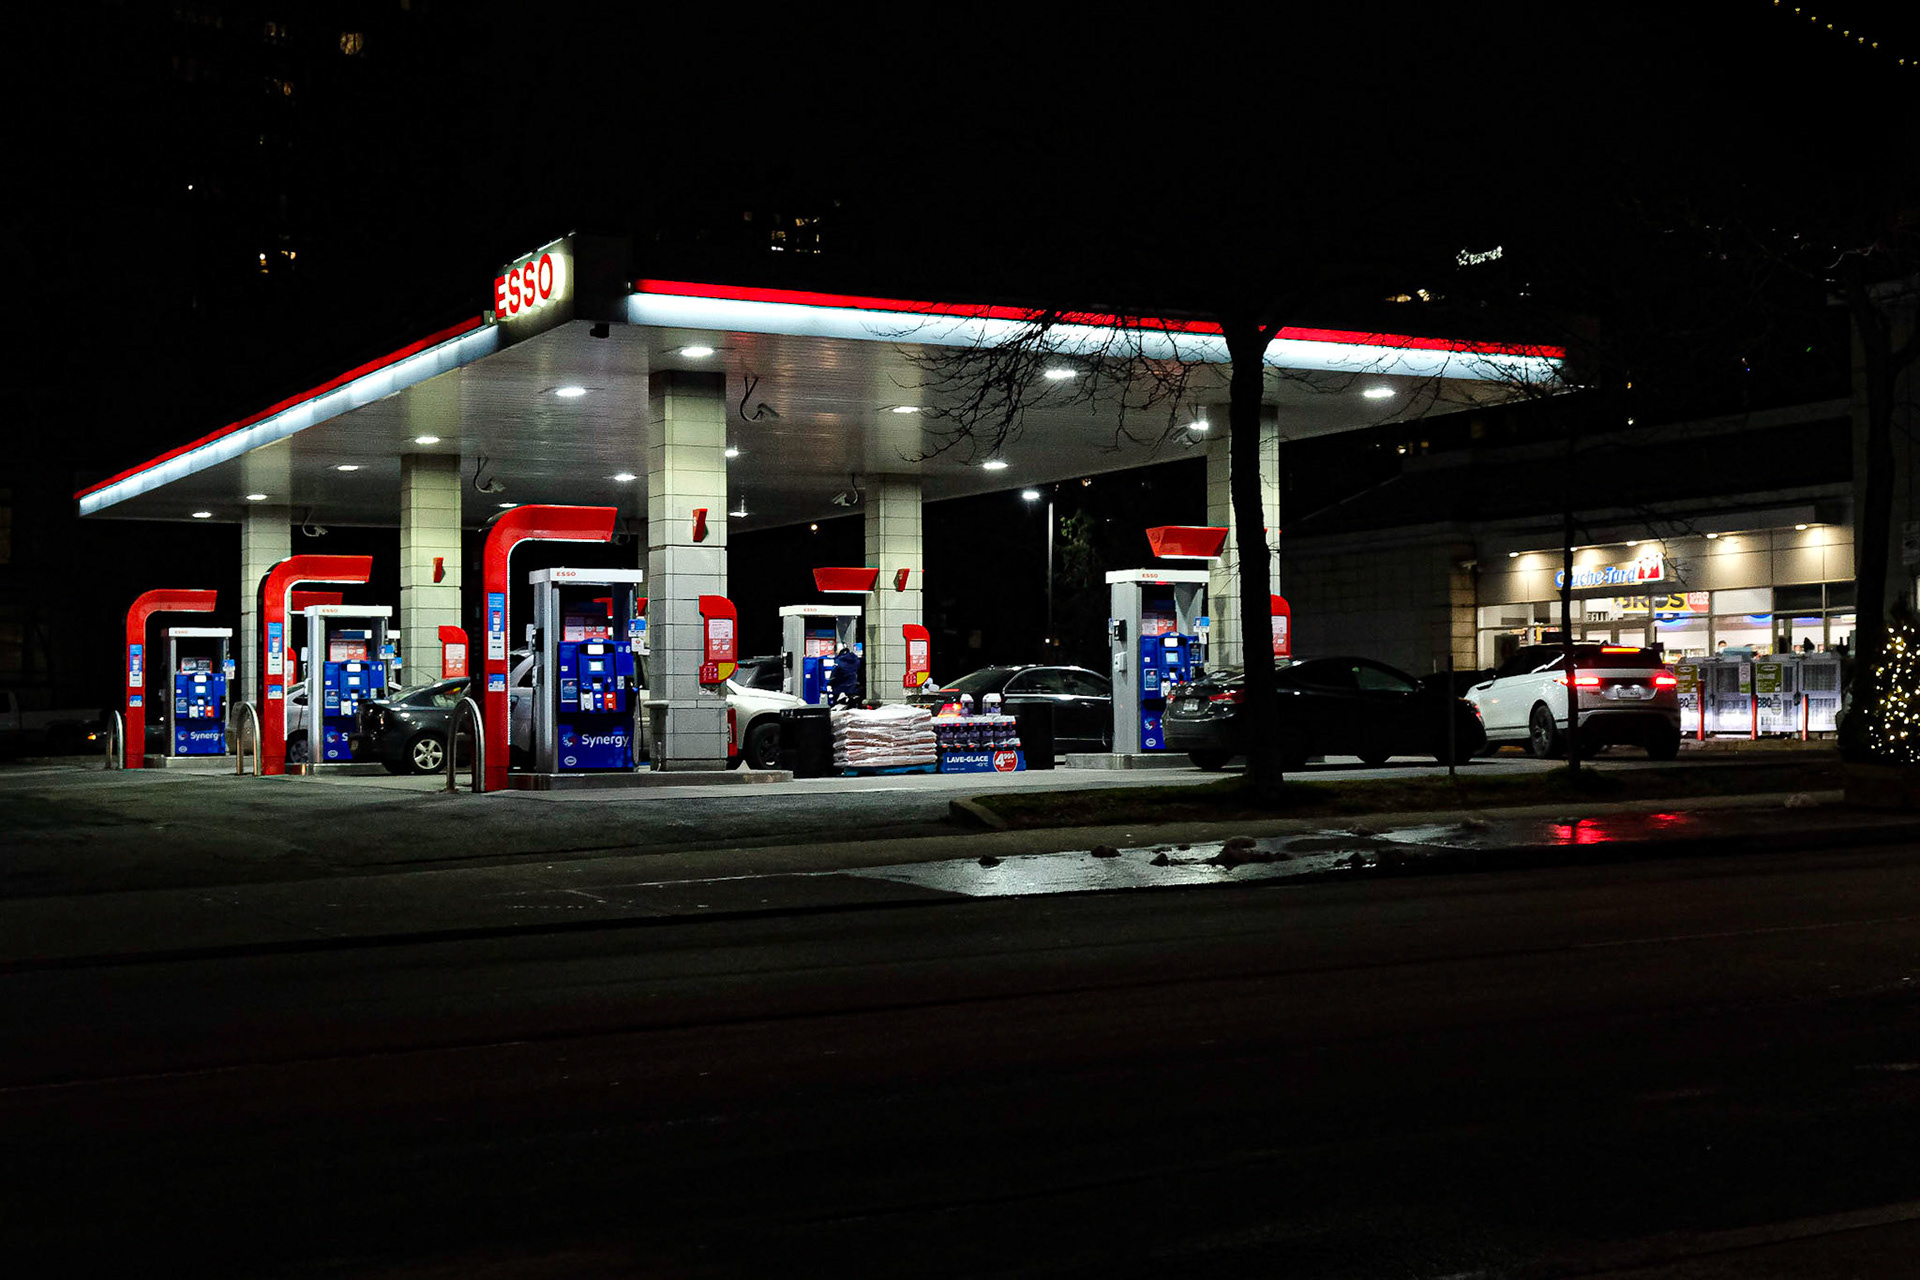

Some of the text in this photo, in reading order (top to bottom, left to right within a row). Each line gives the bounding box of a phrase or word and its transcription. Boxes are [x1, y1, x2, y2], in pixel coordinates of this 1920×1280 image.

[494, 252, 553, 319] ESSO
[1554, 566, 1636, 588] Cuche-Tard
[581, 734, 630, 748] Synergy
[946, 755, 989, 763] LAVE-GLACE
